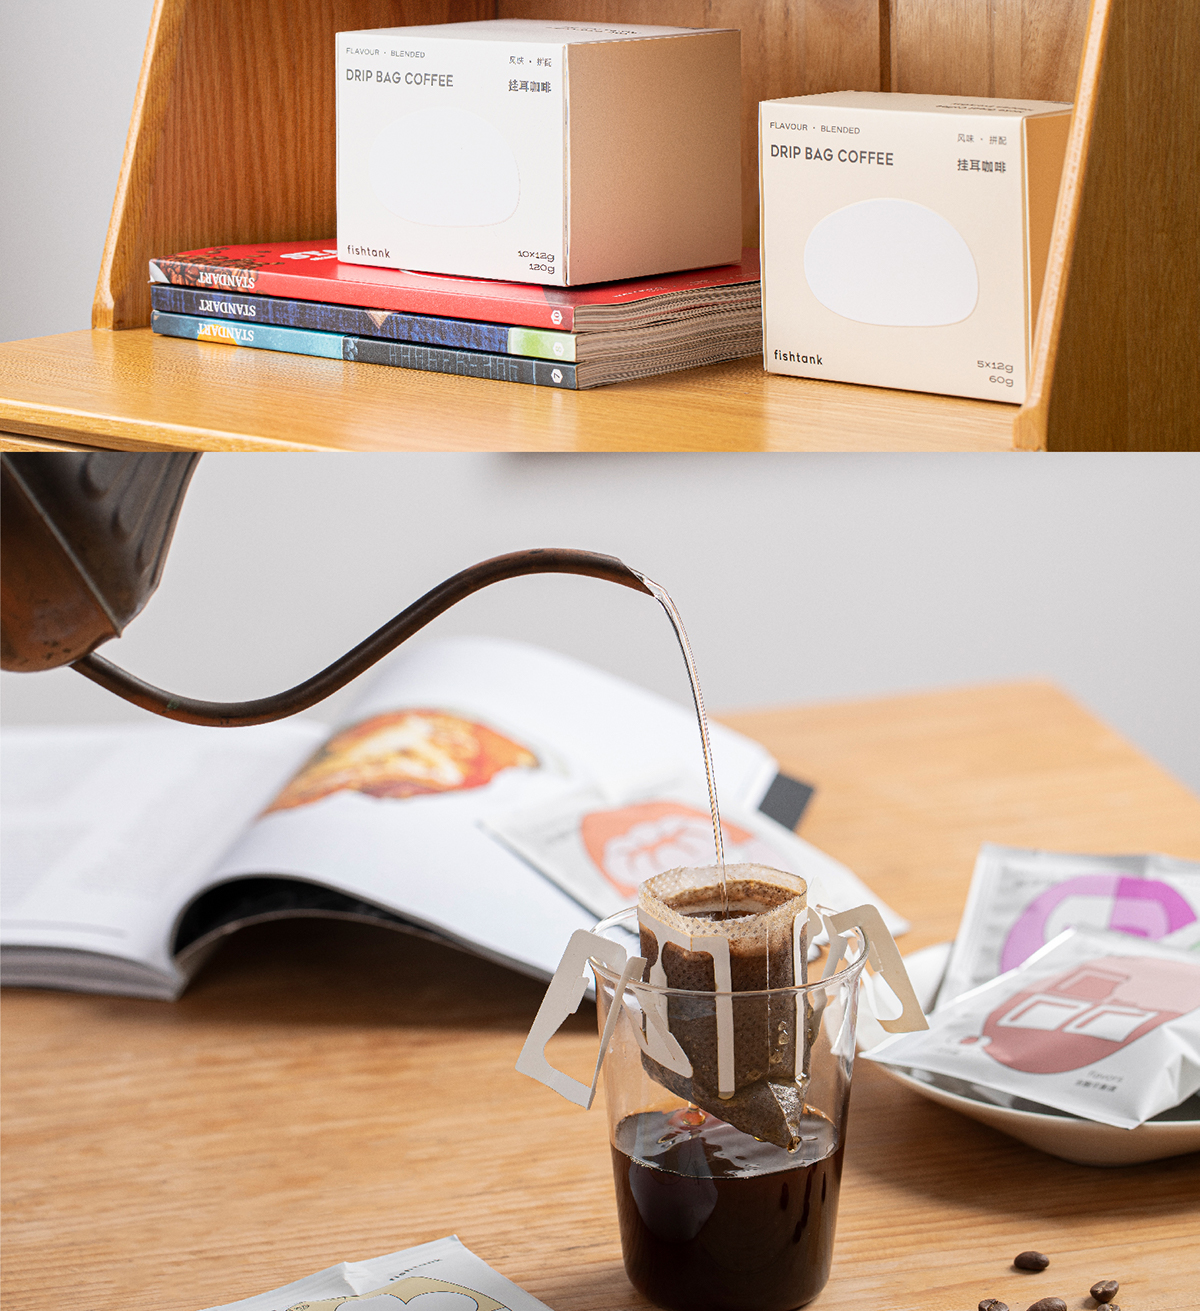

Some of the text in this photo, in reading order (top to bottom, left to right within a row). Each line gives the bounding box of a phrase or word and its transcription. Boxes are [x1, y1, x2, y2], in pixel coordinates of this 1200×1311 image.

[346, 48, 426, 59] FLAVOUR BLENDED
[346, 69, 454, 87] DRIP BAG COFFEE
[508, 79, 552, 93] 挂耳咖啡
[769, 121, 861, 135] FLAVOUR BLENDED
[957, 133, 975, 143] 风味
[770, 144, 894, 166] DRIP BAG COFFEE
[957, 158, 1006, 173] 挂耳咖啡
[347, 244, 391, 259] fishtank
[529, 263, 555, 275] 120g
[198, 271, 255, 289] STANDART
[198, 299, 257, 317] STANDART
[196, 323, 255, 342] STANDART
[773, 349, 823, 366] fishtank
[988, 374, 1014, 388] 60g
